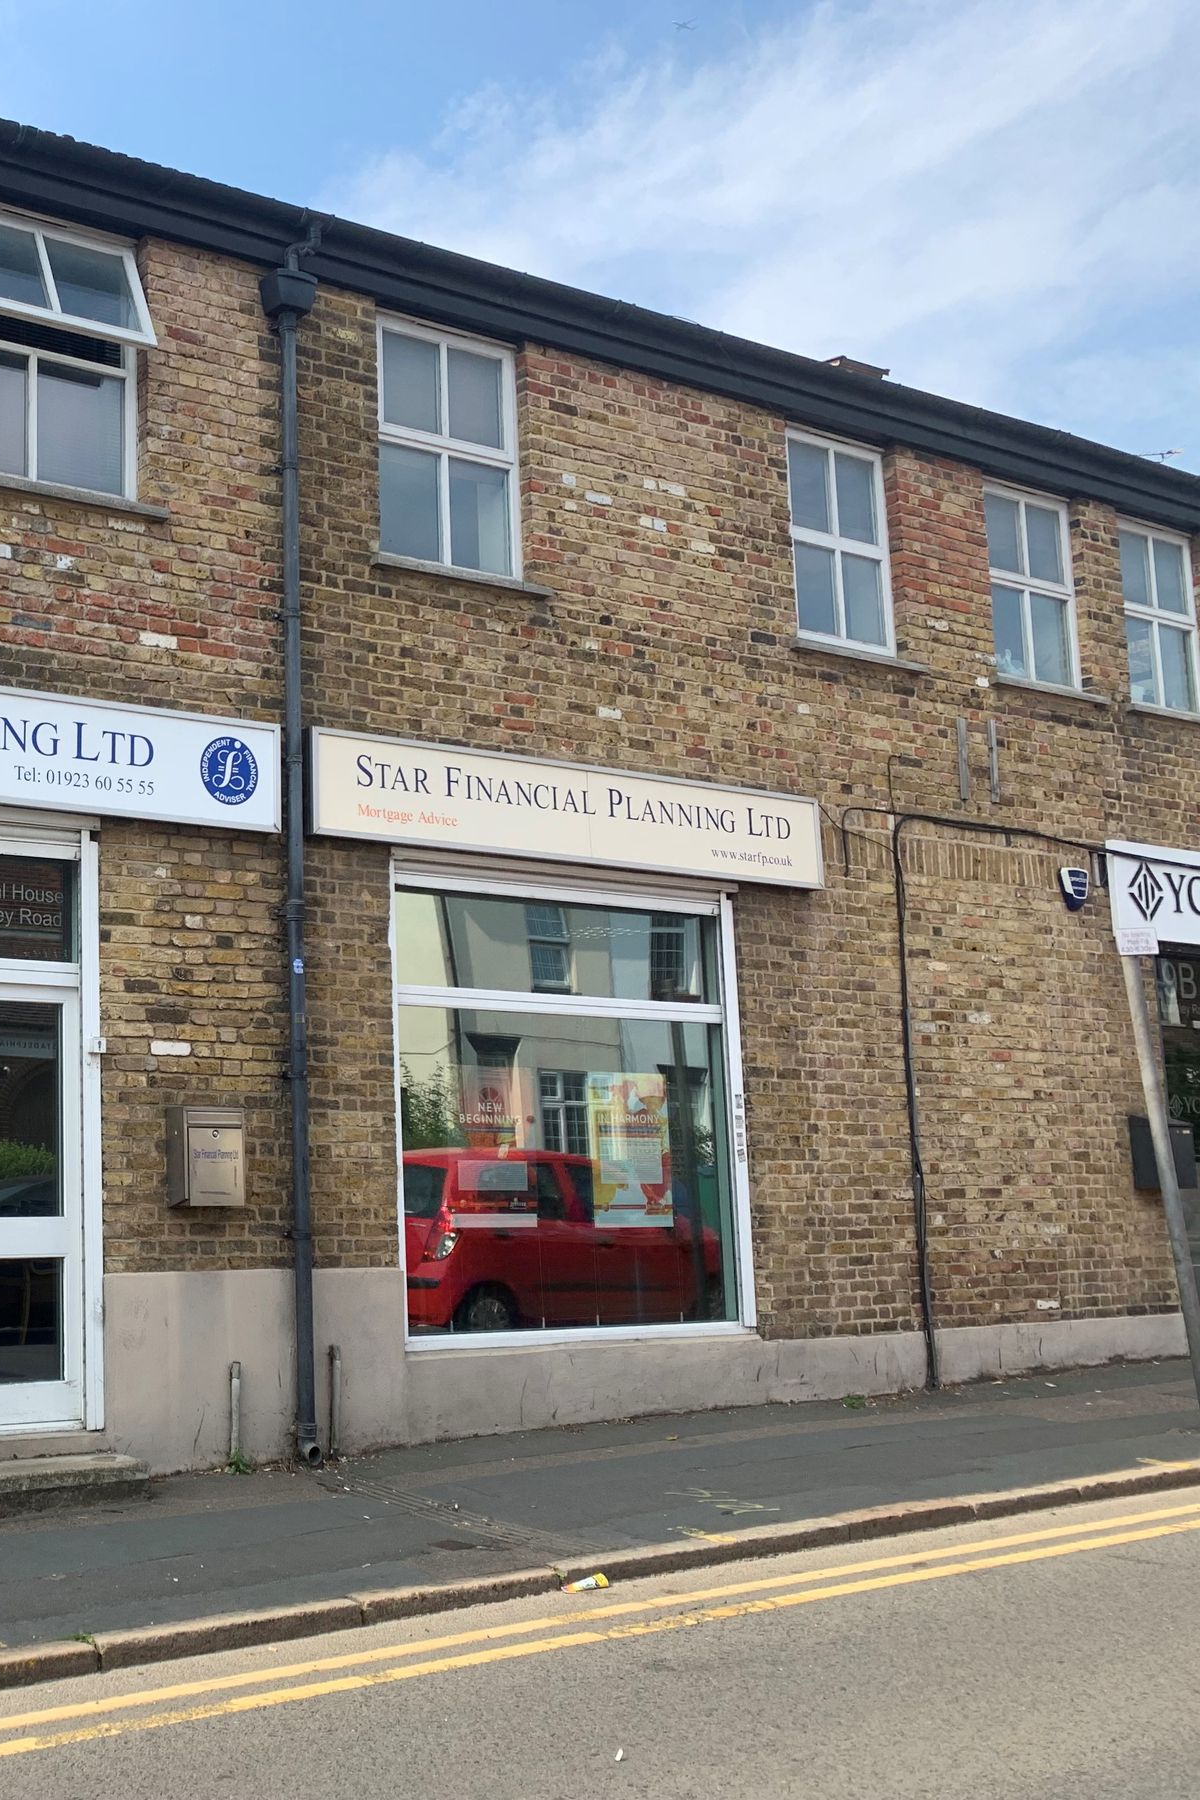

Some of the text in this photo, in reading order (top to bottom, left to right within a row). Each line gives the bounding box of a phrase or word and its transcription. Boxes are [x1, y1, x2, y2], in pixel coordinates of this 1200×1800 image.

[73, 722, 155, 768] LTD
[202, 739, 231, 782] INDEPENDENT
[243, 750, 257, 792] FINANCIAL
[13, 765, 155, 796] Tel: 01923 60 55 55
[214, 791, 246, 804] ADVISER
[356, 754, 792, 840] STAR FINANCIAL PLANNING LTD
[358, 803, 458, 827] Mortgage Advice
[711, 847, 793, 867] www.starfp.co.uk
[11, 884, 64, 904] House
[19, 909, 62, 927] Road
[477, 1102, 503, 1113] NEW
[613, 1113, 660, 1124] HARMONY
